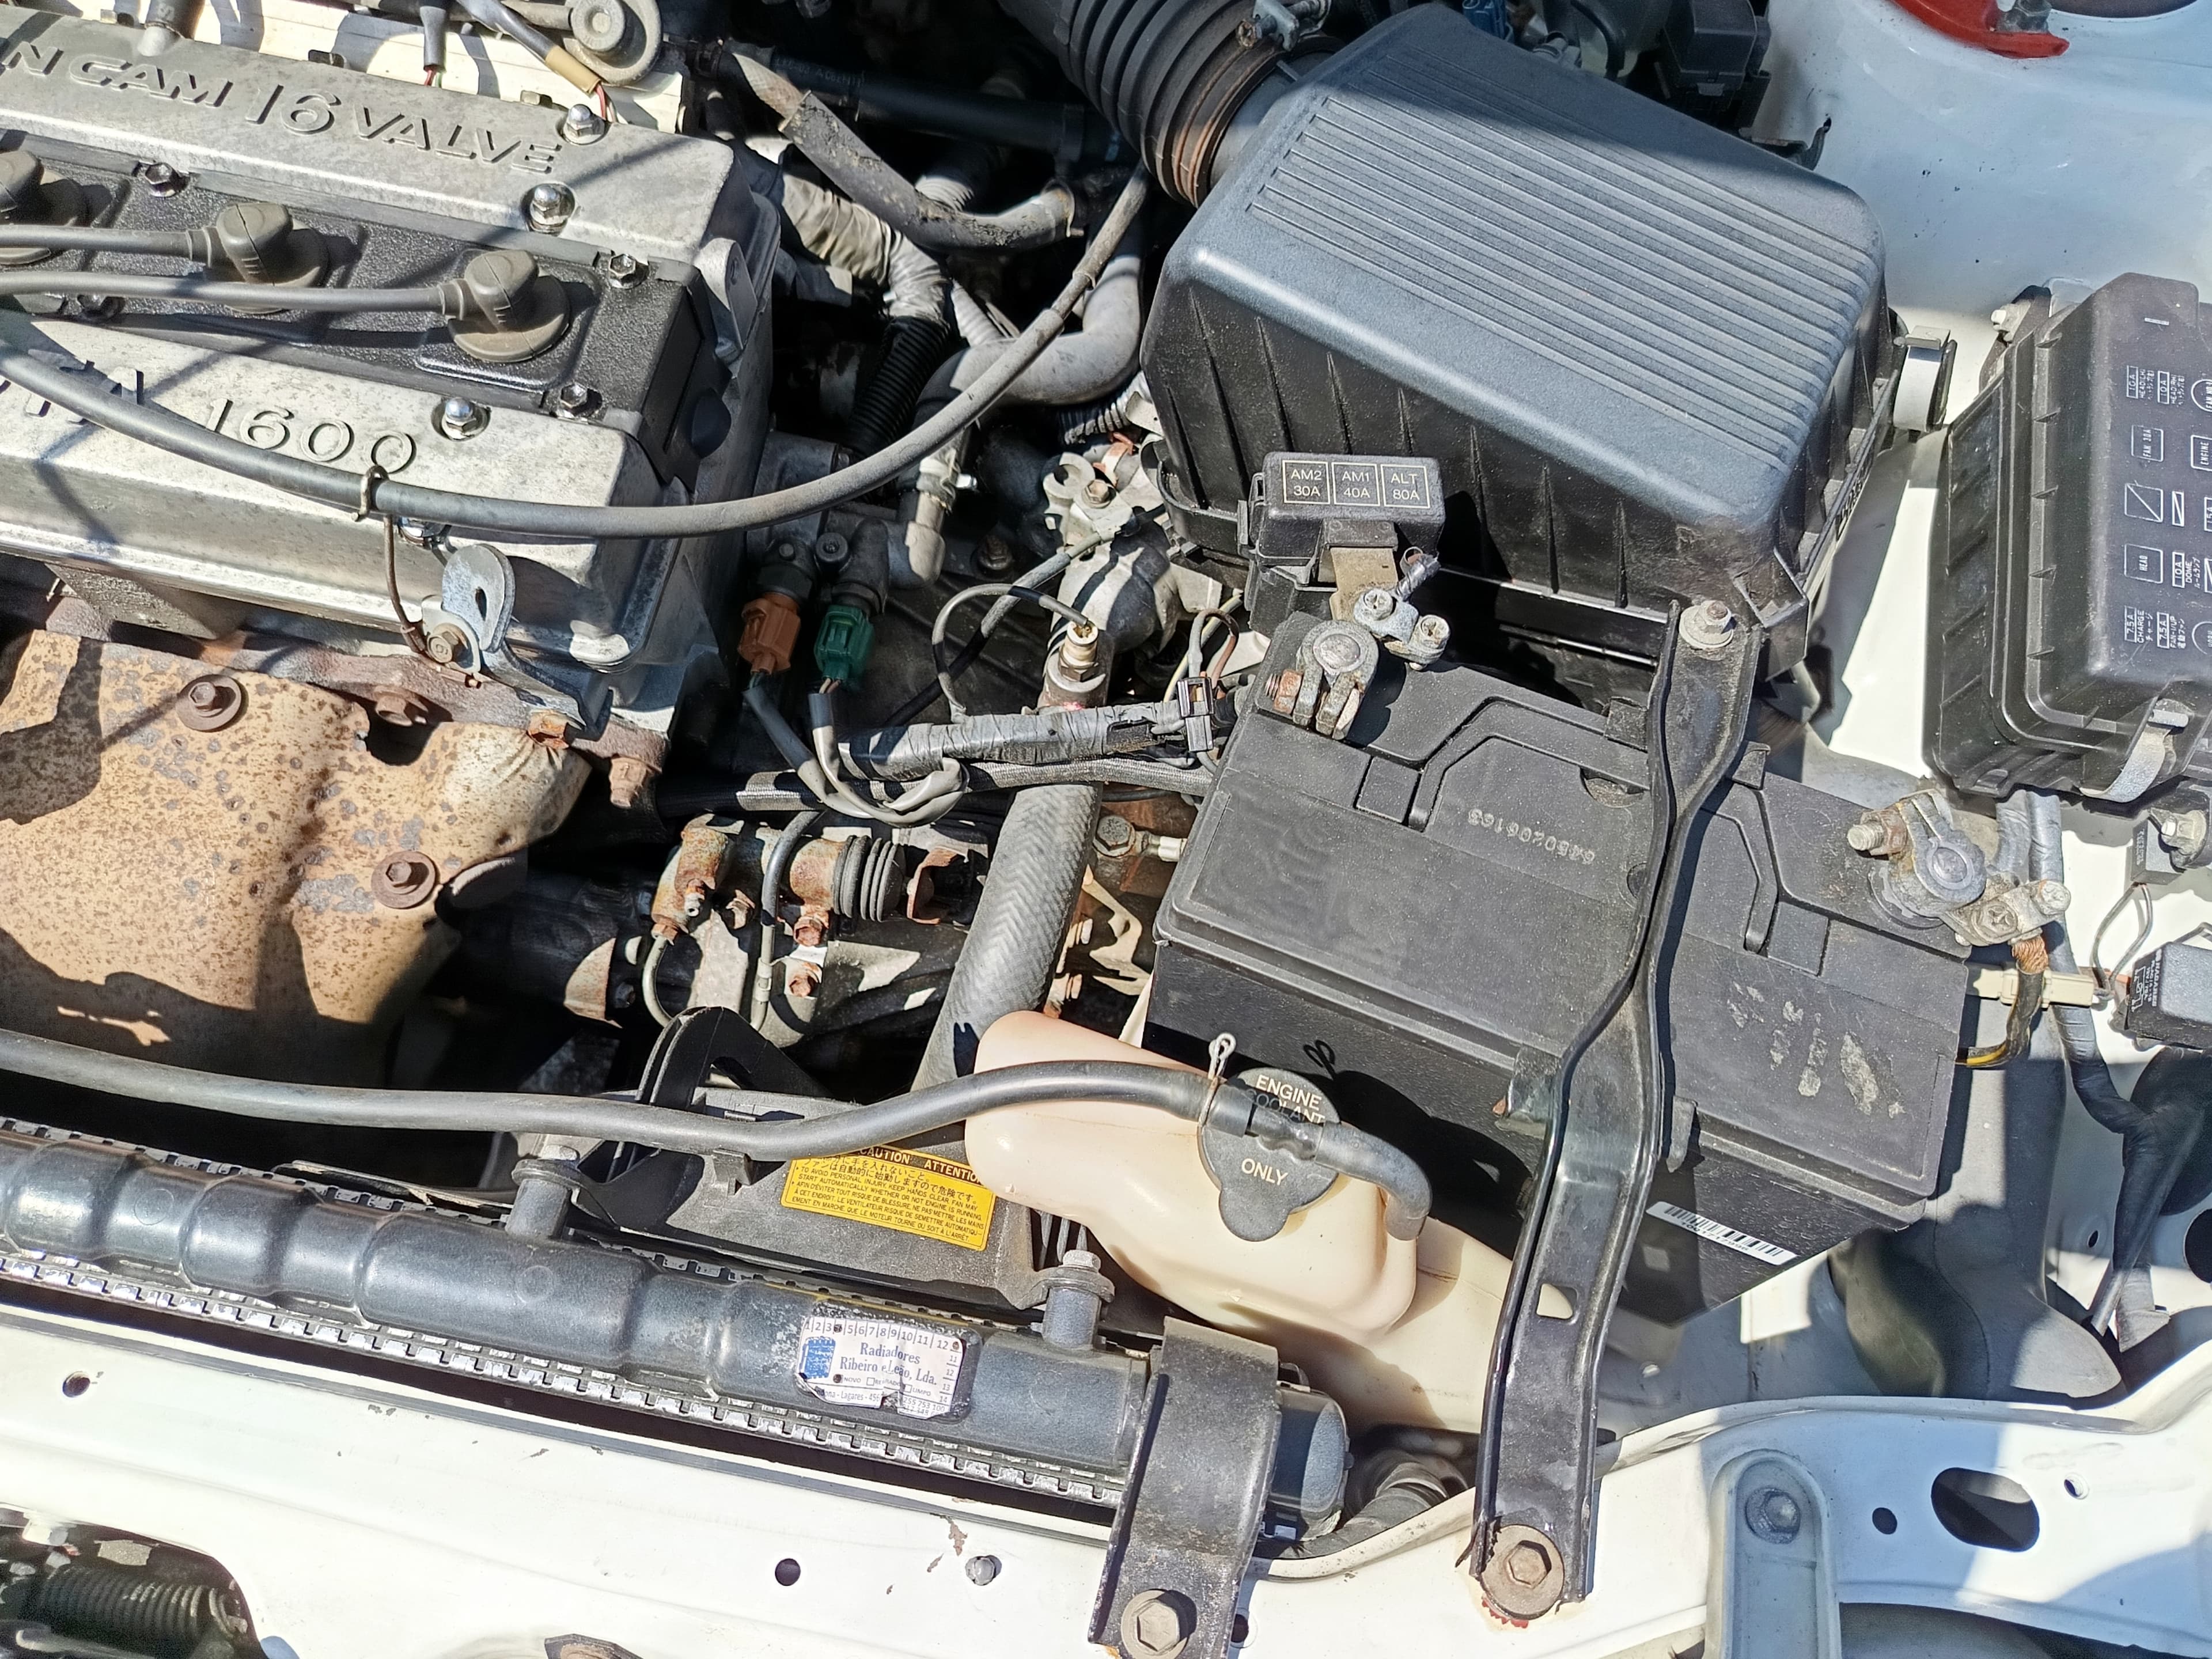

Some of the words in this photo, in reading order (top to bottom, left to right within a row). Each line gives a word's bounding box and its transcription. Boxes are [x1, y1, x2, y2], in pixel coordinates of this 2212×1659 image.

[69, 55, 233, 108] CAM
[245, 85, 341, 135] 16
[353, 103, 562, 174] VALVE
[206, 399, 416, 474] 1600
[2143, 445, 2152, 457] FAN
[2200, 442, 2209, 465] ENGINE
[1290, 469, 1321, 481] AM2
[1342, 471, 1370, 482] AM1
[1391, 473, 1418, 484] ALT
[1293, 486, 1321, 497] 30A
[1343, 487, 1370, 499] 40A
[1393, 490, 1420, 501] 80A
[2139, 555, 2147, 572] HEAD
[2127, 614, 2135, 634] 7.5A
[2158, 620, 2166, 639] 7.5A
[1255, 1074, 1322, 1111] ENGINE
[860, 1147, 911, 1165] CAUTION
[924, 1159, 982, 1184] ATTENTIO
[1241, 1158, 1289, 1186] ONLY
[798, 1172, 817, 1183] START
[820, 1176, 868, 1193] AUTOMATICALLY
[870, 1187, 899, 1199] WHETHER
[925, 1199, 947, 1210] ENGINE
[810, 1167, 828, 1177] AVOID
[830, 1171, 862, 1184] PERSONAL
[888, 1183, 905, 1192] KEEP
[907, 1187, 927, 1197] HANDS
[791, 1195, 811, 1205] EMENT
[847, 1206, 858, 1214] QUE
[869, 1211, 892, 1222] MOTEUR
[893, 1217, 916, 1227] TOURNE
[797, 1180, 809, 1188] AFIN
[836, 1188, 850, 1196] TOUT
[851, 1191, 872, 1200] RISQUE
[933, 1210, 955, 1221] METTRE
[967, 1219, 984, 1229] MAINS
[846, 1197, 882, 1211] VENTILATEUR
[884, 1206, 904, 1216] RISQUE
[815, 1322, 821, 1331] 2
[826, 1323, 832, 1331] 3
[847, 1325, 853, 1334] 5
[858, 1326, 865, 1335] 6
[869, 1327, 875, 1335] 7
[880, 1328, 887, 1336] 8
[891, 1329, 897, 1337] 9
[902, 1331, 913, 1342] 10
[917, 1335, 928, 1345] 11
[937, 1340, 949, 1350] 12
[860, 1342, 921, 1364] Radiadores
[949, 1355, 957, 1363] 11
[840, 1357, 878, 1372] Ribeiro
[916, 1368, 937, 1385] Lda.
[946, 1369, 955, 1377] 12
[841, 1391, 863, 1401] Lagares
[912, 1388, 931, 1396] LIMPO
[942, 1383, 950, 1391] 13
[903, 1397, 916, 1406] 255
[918, 1400, 930, 1409] 753
[933, 1404, 945, 1412] 100
[939, 1395, 948, 1403] 14
